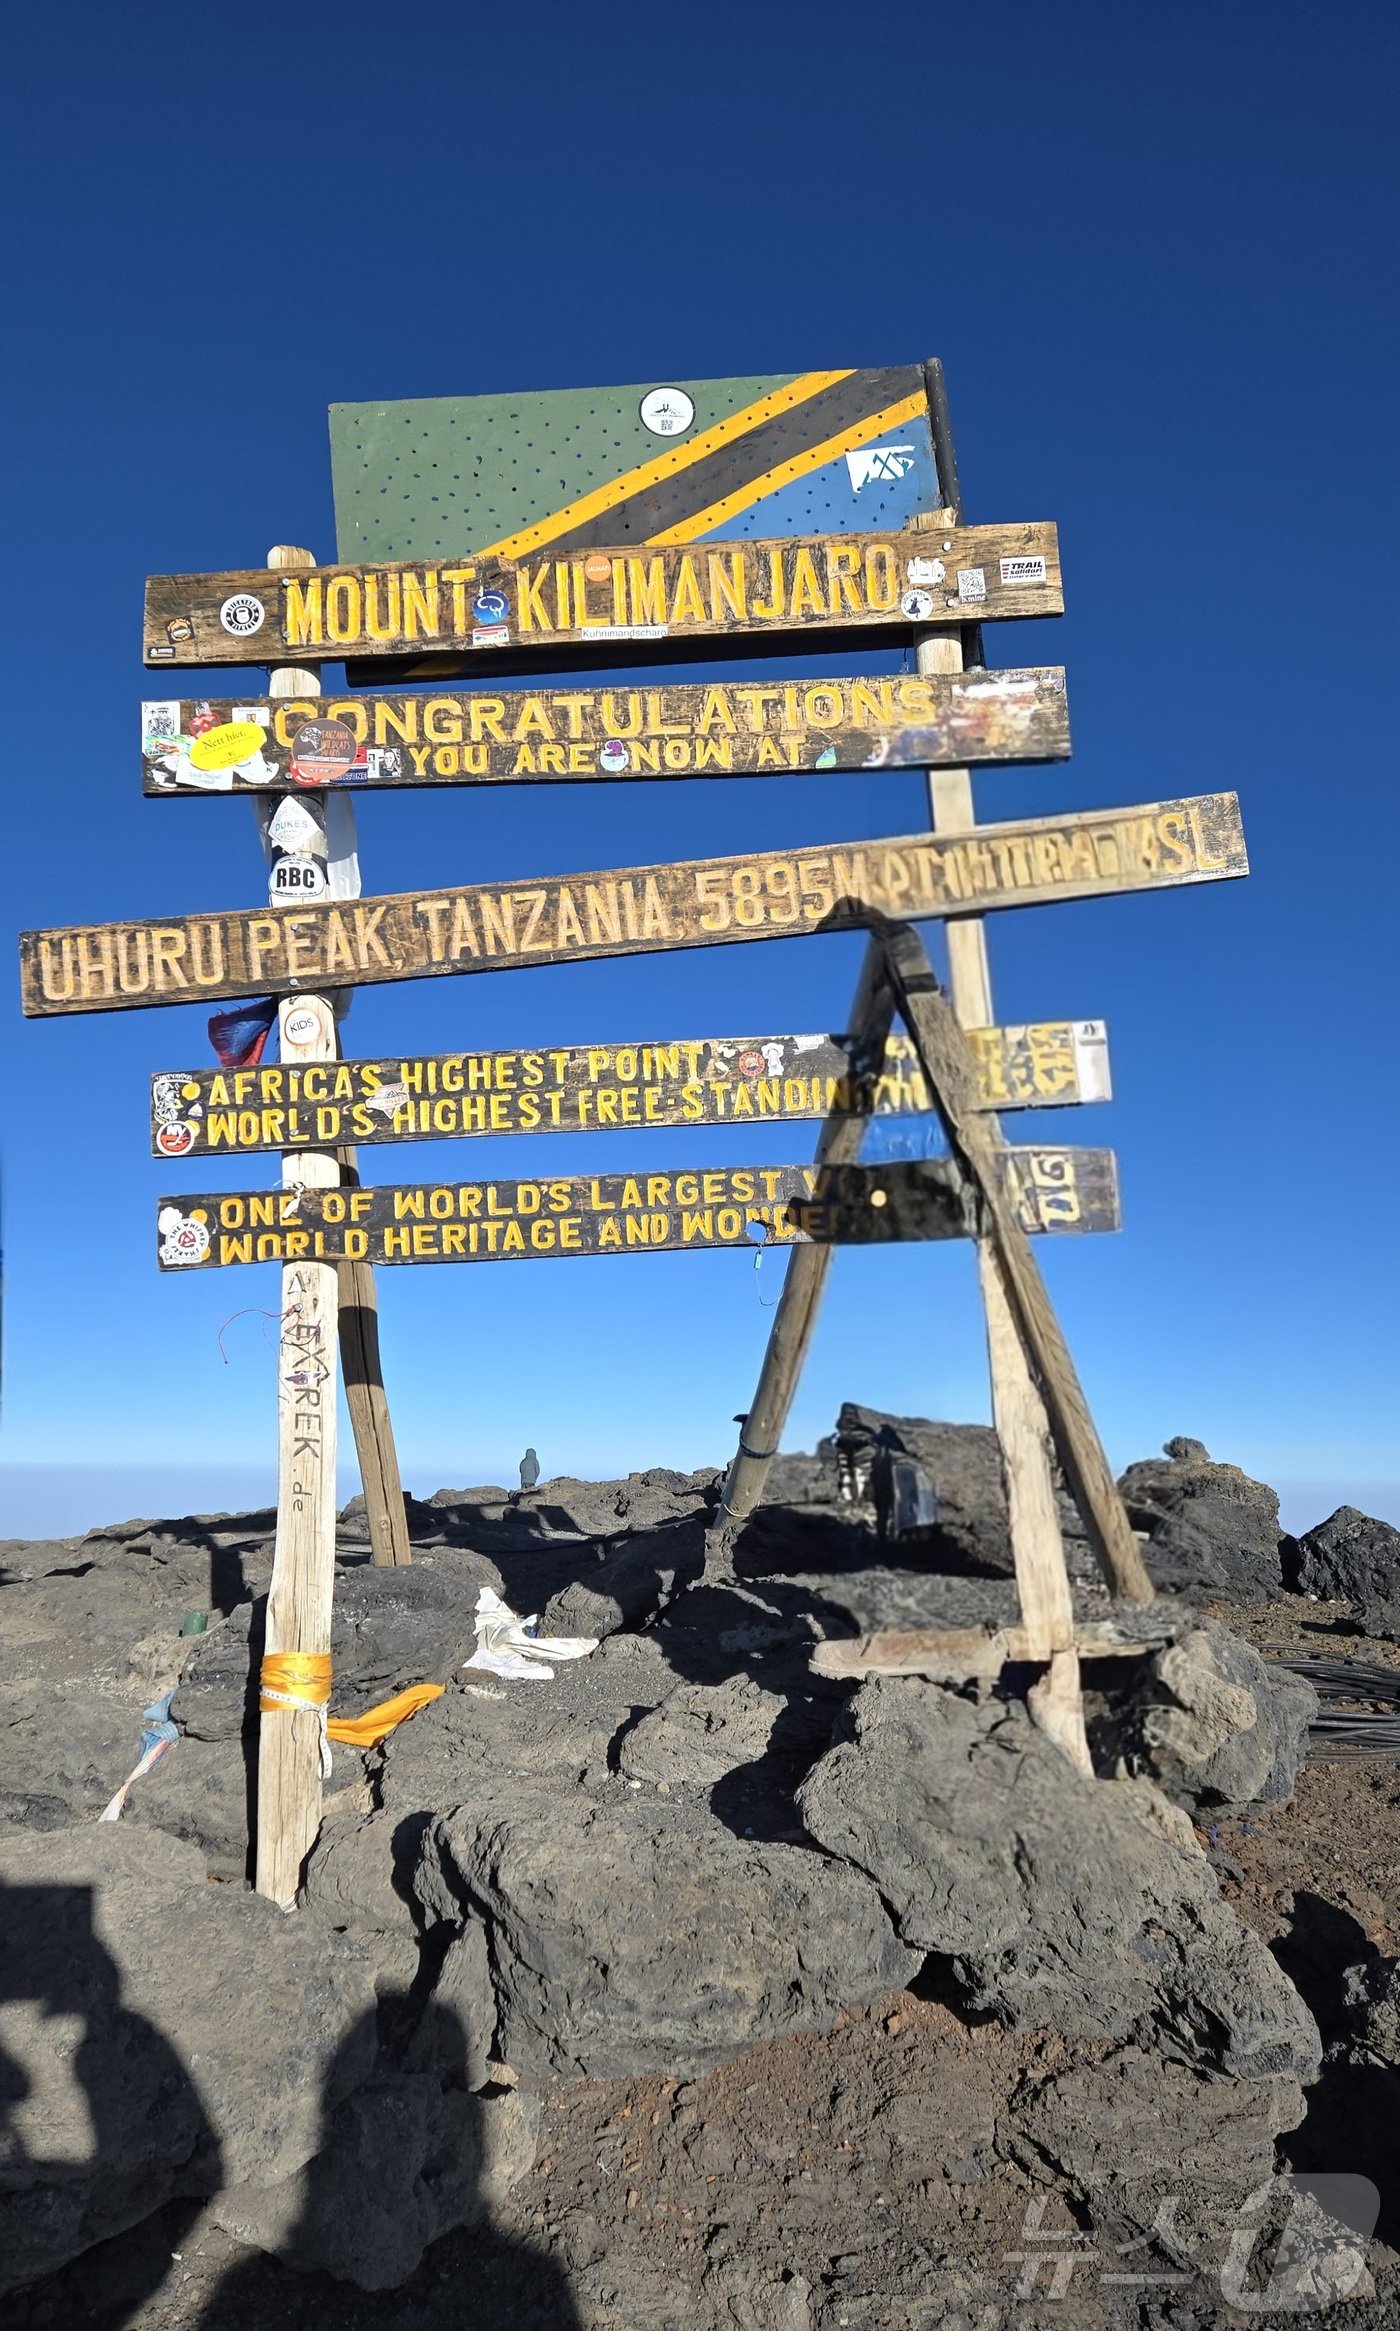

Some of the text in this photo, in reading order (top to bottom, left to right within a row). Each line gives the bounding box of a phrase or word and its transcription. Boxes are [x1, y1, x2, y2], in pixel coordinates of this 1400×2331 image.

[1011, 561, 1043, 570] TRAIL
[286, 543, 897, 646] MOUNT KILIMANJARO
[275, 681, 937, 748] CONGRATULATIONS
[409, 744, 489, 776] YOU
[516, 742, 596, 774] ARE
[631, 738, 732, 772] NOW
[758, 735, 805, 767] AT
[277, 867, 315, 888] RBC
[40, 923, 224, 1001] UHURU
[248, 904, 403, 982] PEAK,
[290, 1018, 314, 1033] KIDS
[400, 1051, 569, 1096] HIGHEST
[589, 1041, 705, 1085] POINT
[166, 1124, 185, 1136] NY
[393, 1090, 565, 1135] HIGHEST
[219, 1194, 302, 1228] ONE
[322, 1192, 374, 1224] OF
[591, 1170, 782, 1211] LARGEST
[383, 1217, 584, 1257] HERITAGE
[599, 1212, 669, 1247] AND
